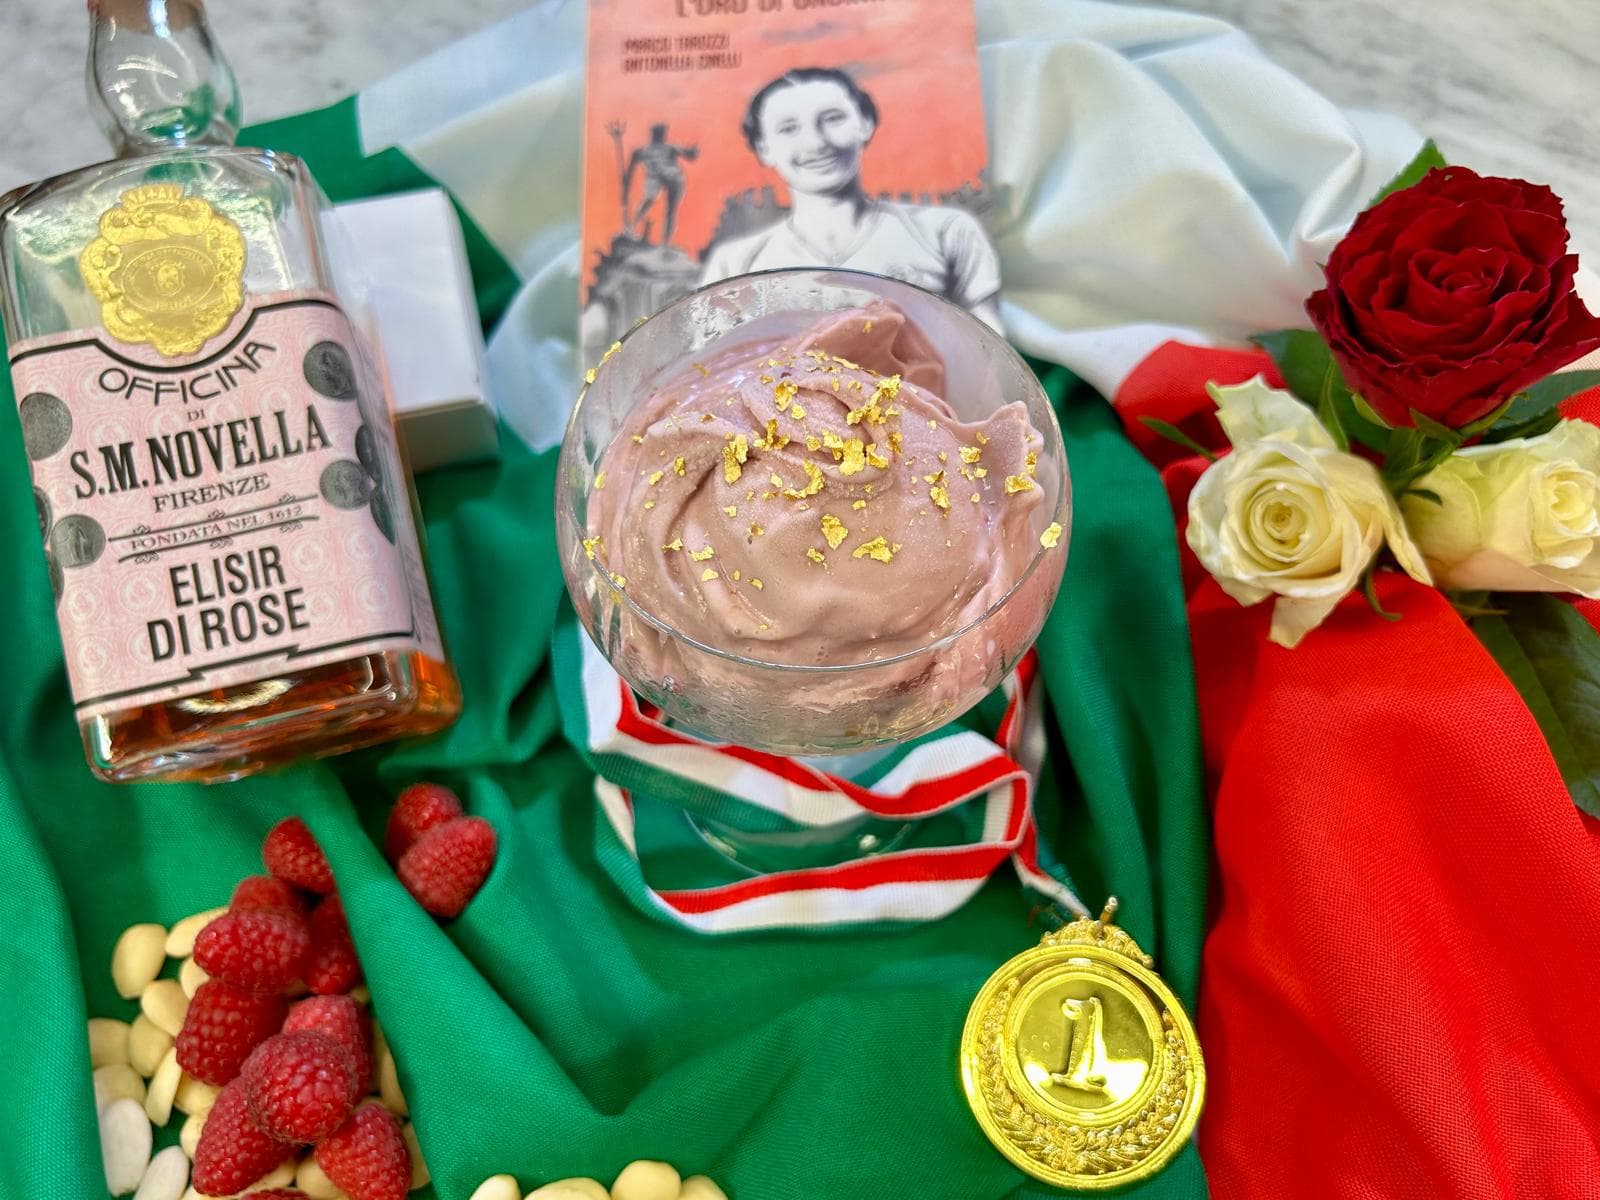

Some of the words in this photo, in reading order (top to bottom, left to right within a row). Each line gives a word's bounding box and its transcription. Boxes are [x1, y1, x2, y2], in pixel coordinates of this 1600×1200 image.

[99, 341, 277, 406] OFFICINA
[187, 408, 206, 422] DI
[70, 404, 334, 499] S.M.NOVELLA
[154, 472, 271, 514] FIRENZE
[131, 524, 223, 551] FONDATA
[226, 513, 264, 531] NEL
[268, 505, 304, 523] 1612
[169, 544, 287, 608] ELISIR
[147, 612, 191, 662] DI
[200, 587, 311, 650] ROSE
[1050, 996, 1108, 1093] 1
